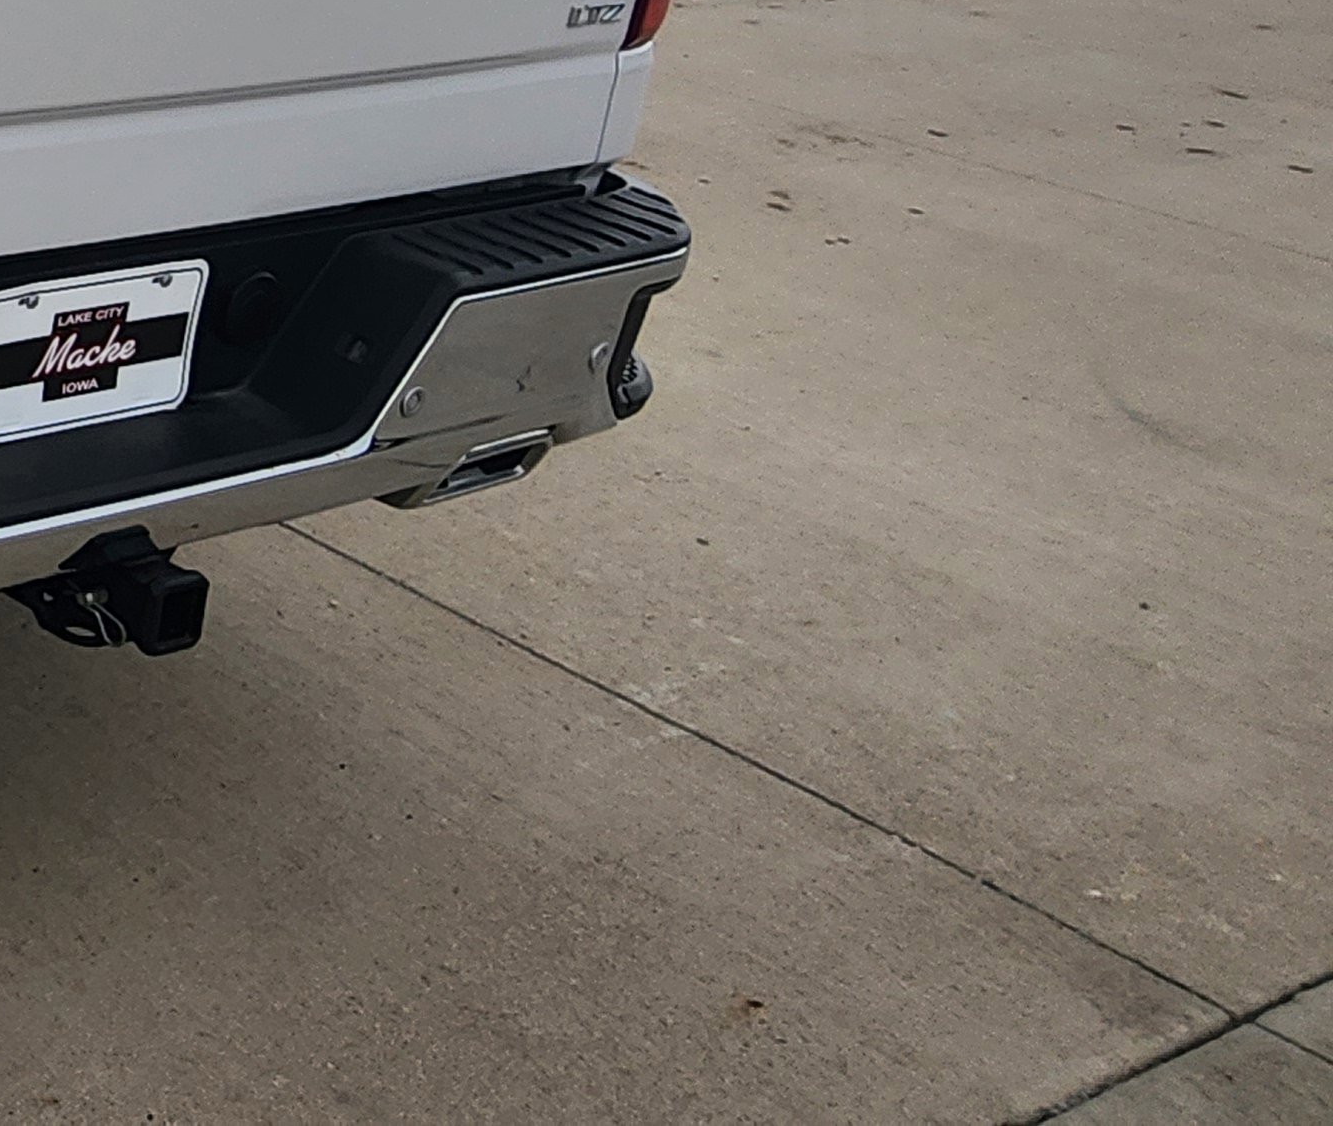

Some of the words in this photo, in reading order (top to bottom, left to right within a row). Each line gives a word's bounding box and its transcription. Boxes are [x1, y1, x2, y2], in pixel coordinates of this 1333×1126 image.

[566, 3, 625, 28] LTZ
[57, 311, 93, 327] LAKE
[95, 306, 125, 320] CITY
[32, 324, 136, 378] Macke
[61, 378, 99, 394] IOWA
